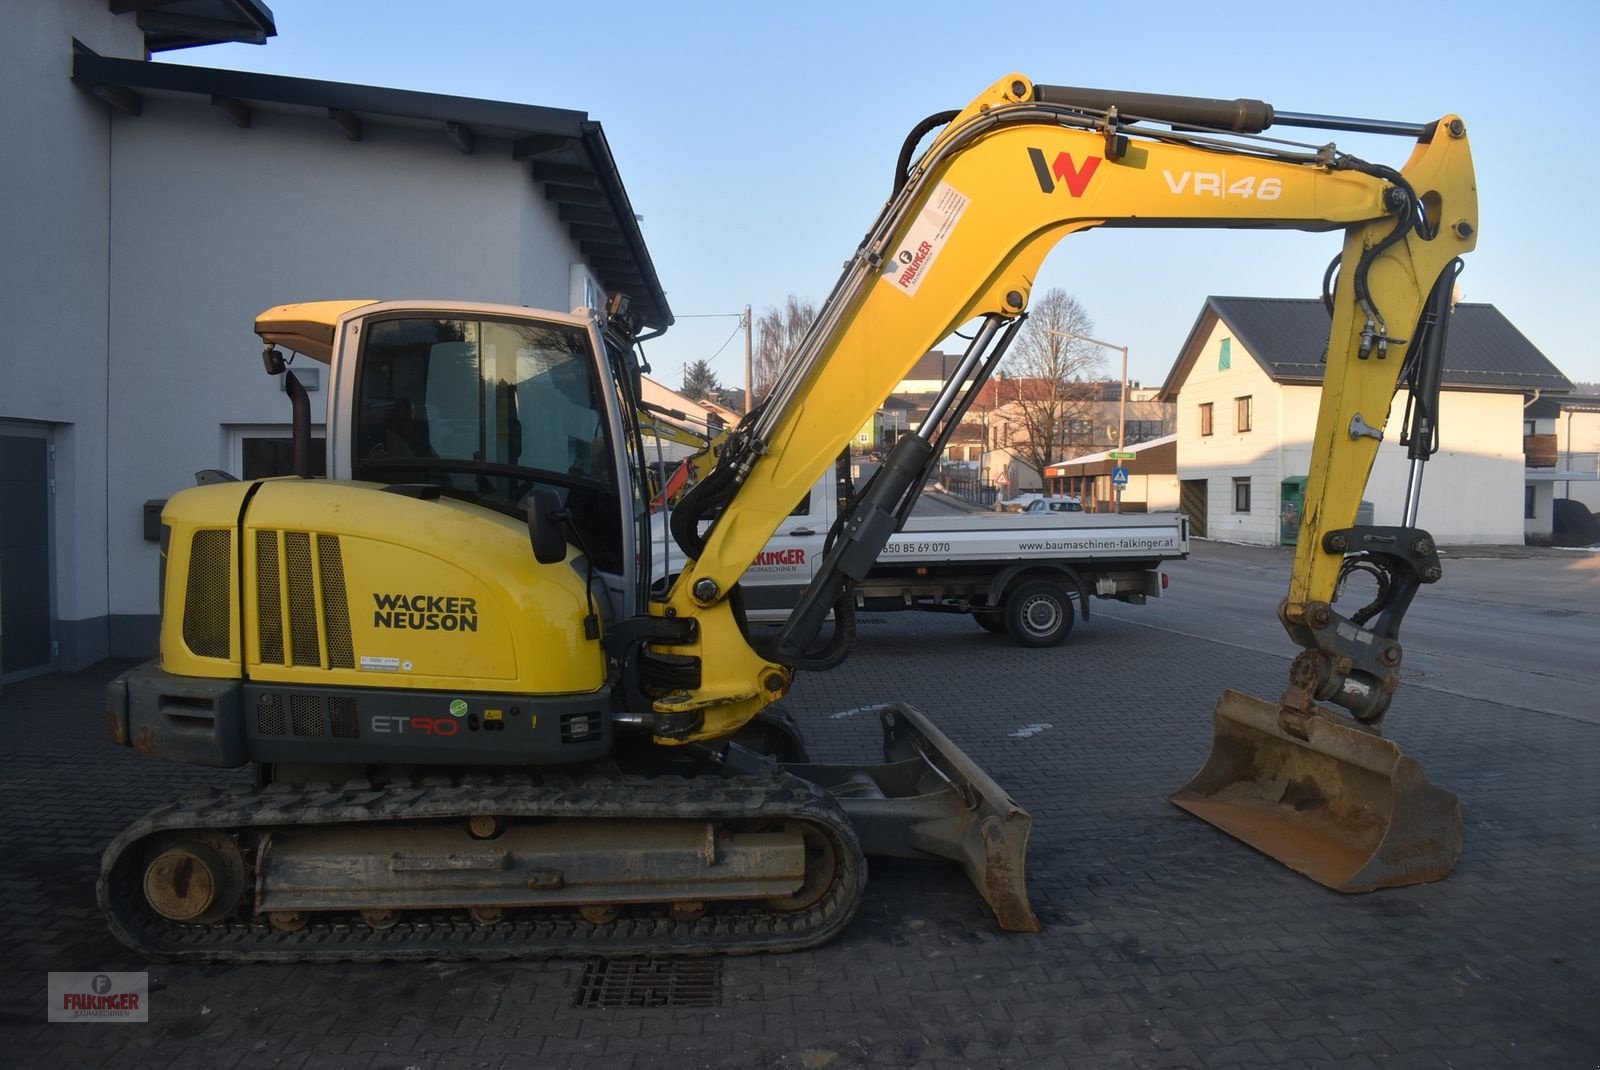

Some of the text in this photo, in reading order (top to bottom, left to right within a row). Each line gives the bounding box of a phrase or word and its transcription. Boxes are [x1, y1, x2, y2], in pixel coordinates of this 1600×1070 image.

[898, 240, 932, 288] FALKINGER
[903, 543, 915, 553] 85
[917, 542, 930, 552] 69
[932, 542, 950, 552] 070
[1019, 538, 1173, 550] www.baumaschinen-falkinger.at
[373, 593, 478, 614] WACKER
[374, 611, 478, 632] NEUSON
[371, 715, 459, 736] ET90
